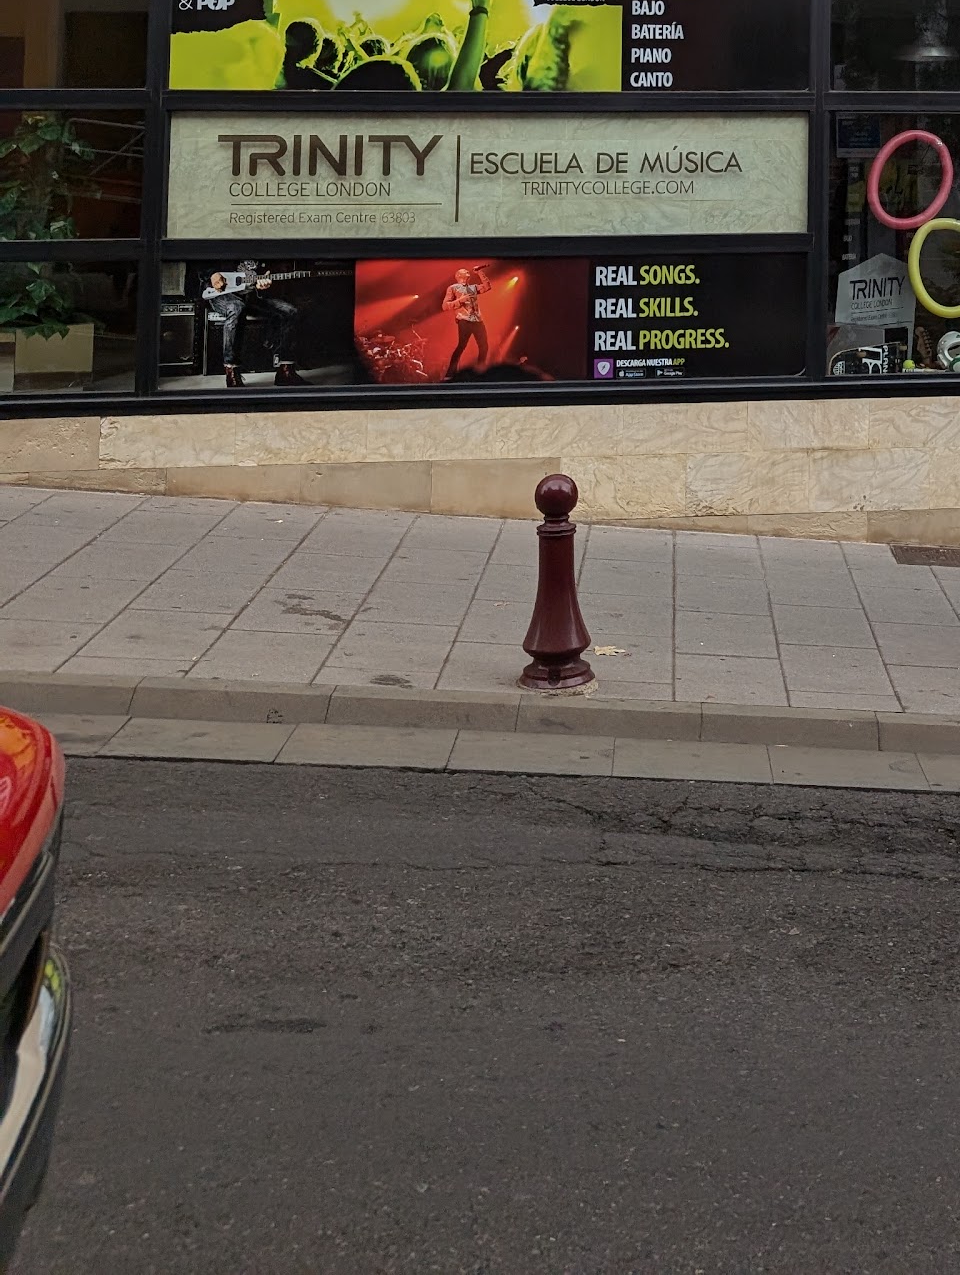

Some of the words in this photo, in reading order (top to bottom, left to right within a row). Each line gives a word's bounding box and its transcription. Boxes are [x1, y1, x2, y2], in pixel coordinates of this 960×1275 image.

[631, 0, 666, 16] BAJO
[631, 21, 685, 40] BATERÍA
[630, 47, 672, 64] PIANO
[630, 71, 674, 88] CANTO
[217, 134, 444, 177] TRINITY
[470, 151, 584, 175] ESCUELA
[596, 151, 629, 174] DE
[639, 145, 743, 174] MÚSICA
[228, 181, 311, 197] COLLEGE
[315, 181, 392, 197] LONDON
[521, 180, 695, 196] TRINITYCOLLEGE.COM
[229, 211, 295, 226] Registered
[299, 211, 332, 224] Exam
[335, 211, 377, 224] Centre
[381, 211, 416, 224] 63803
[595, 266, 638, 287] REAL
[639, 264, 701, 285] SONGS.
[849, 276, 906, 301] TRINITY
[594, 298, 637, 319] REAL
[638, 297, 699, 318] SKILLS.
[850, 300, 873, 310] COLLEGE
[874, 298, 893, 308] LONDON
[594, 330, 637, 351] REAL
[638, 328, 730, 350] PROGRESS.
[616, 359, 647, 367] DESCARGA
[646, 358, 673, 367] NUESTRA
[672, 357, 686, 366] APP
